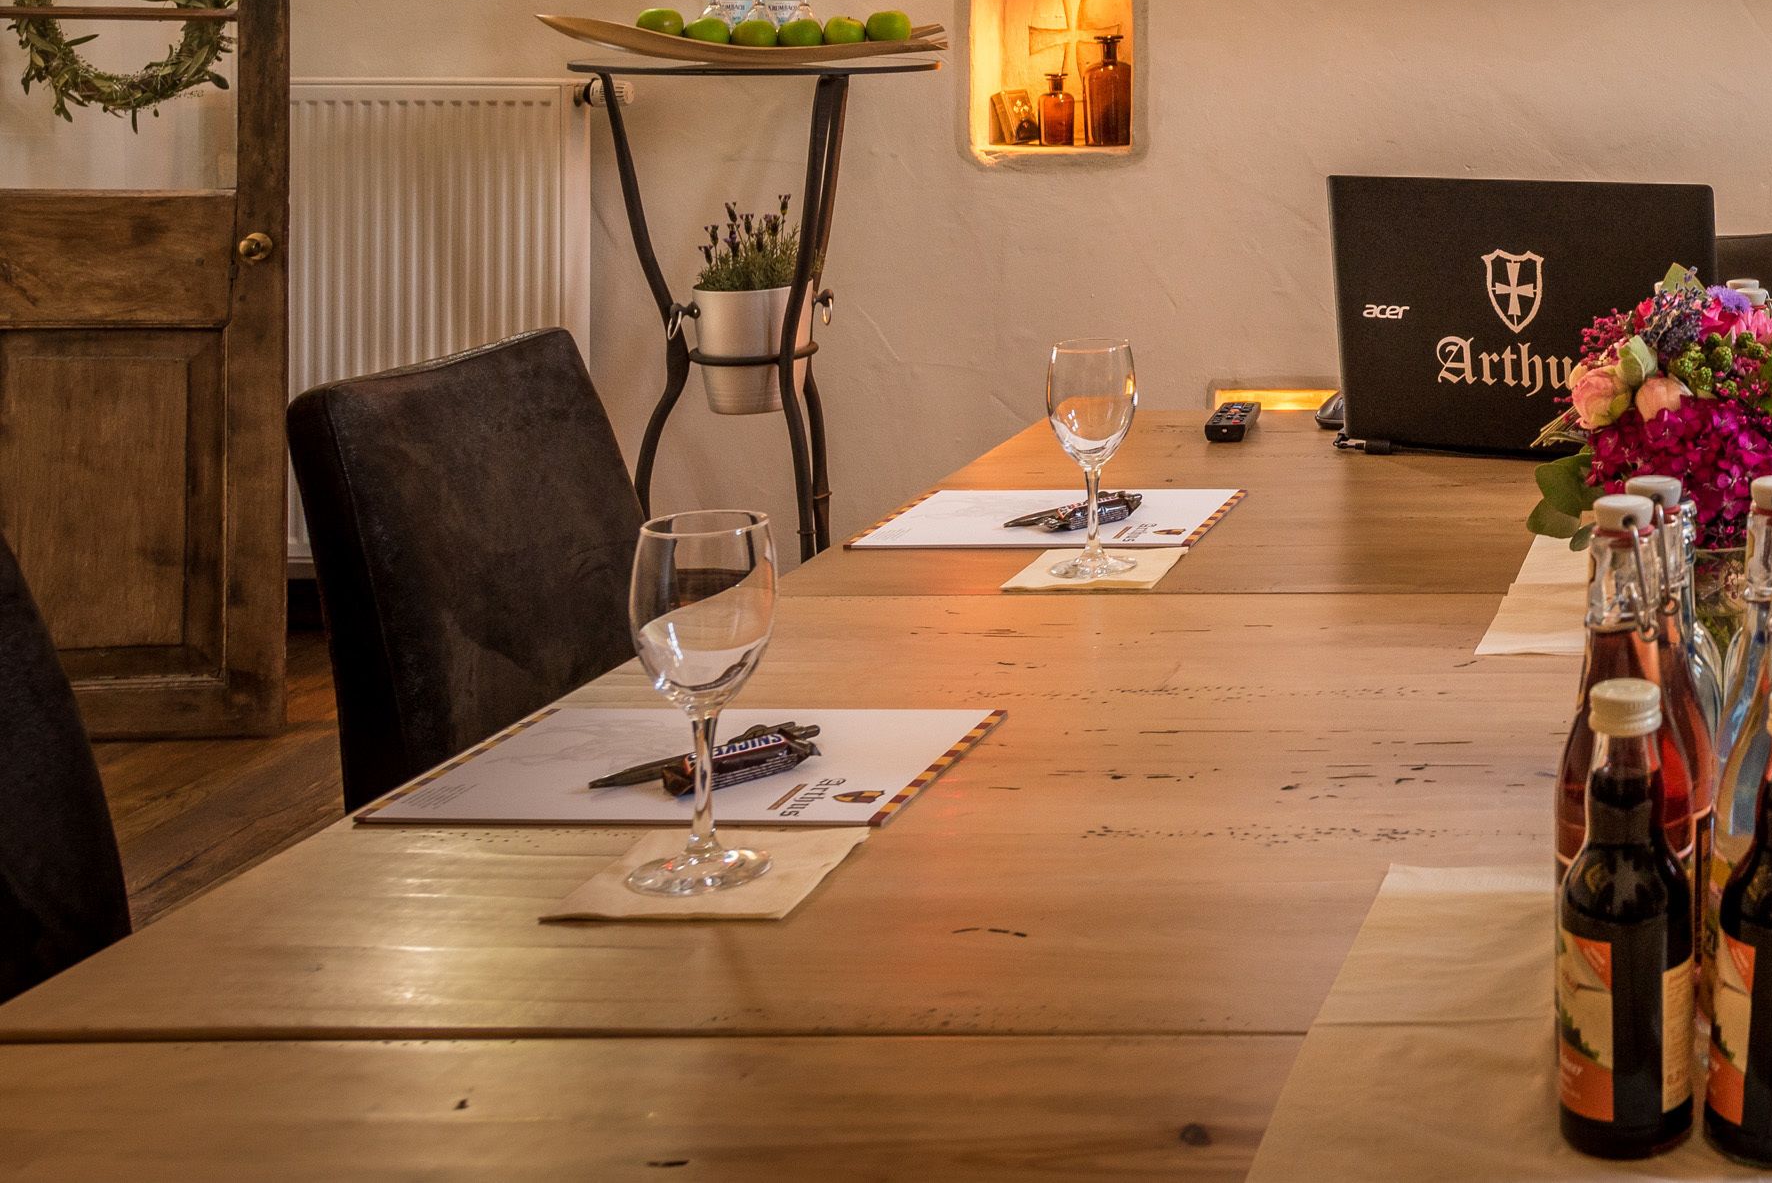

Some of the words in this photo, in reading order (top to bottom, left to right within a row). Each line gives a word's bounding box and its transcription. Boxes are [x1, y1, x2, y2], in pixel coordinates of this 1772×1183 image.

[1362, 304, 1410, 320] acer
[1436, 335, 1573, 397] Arthu
[688, 734, 782, 762] SNICKE
